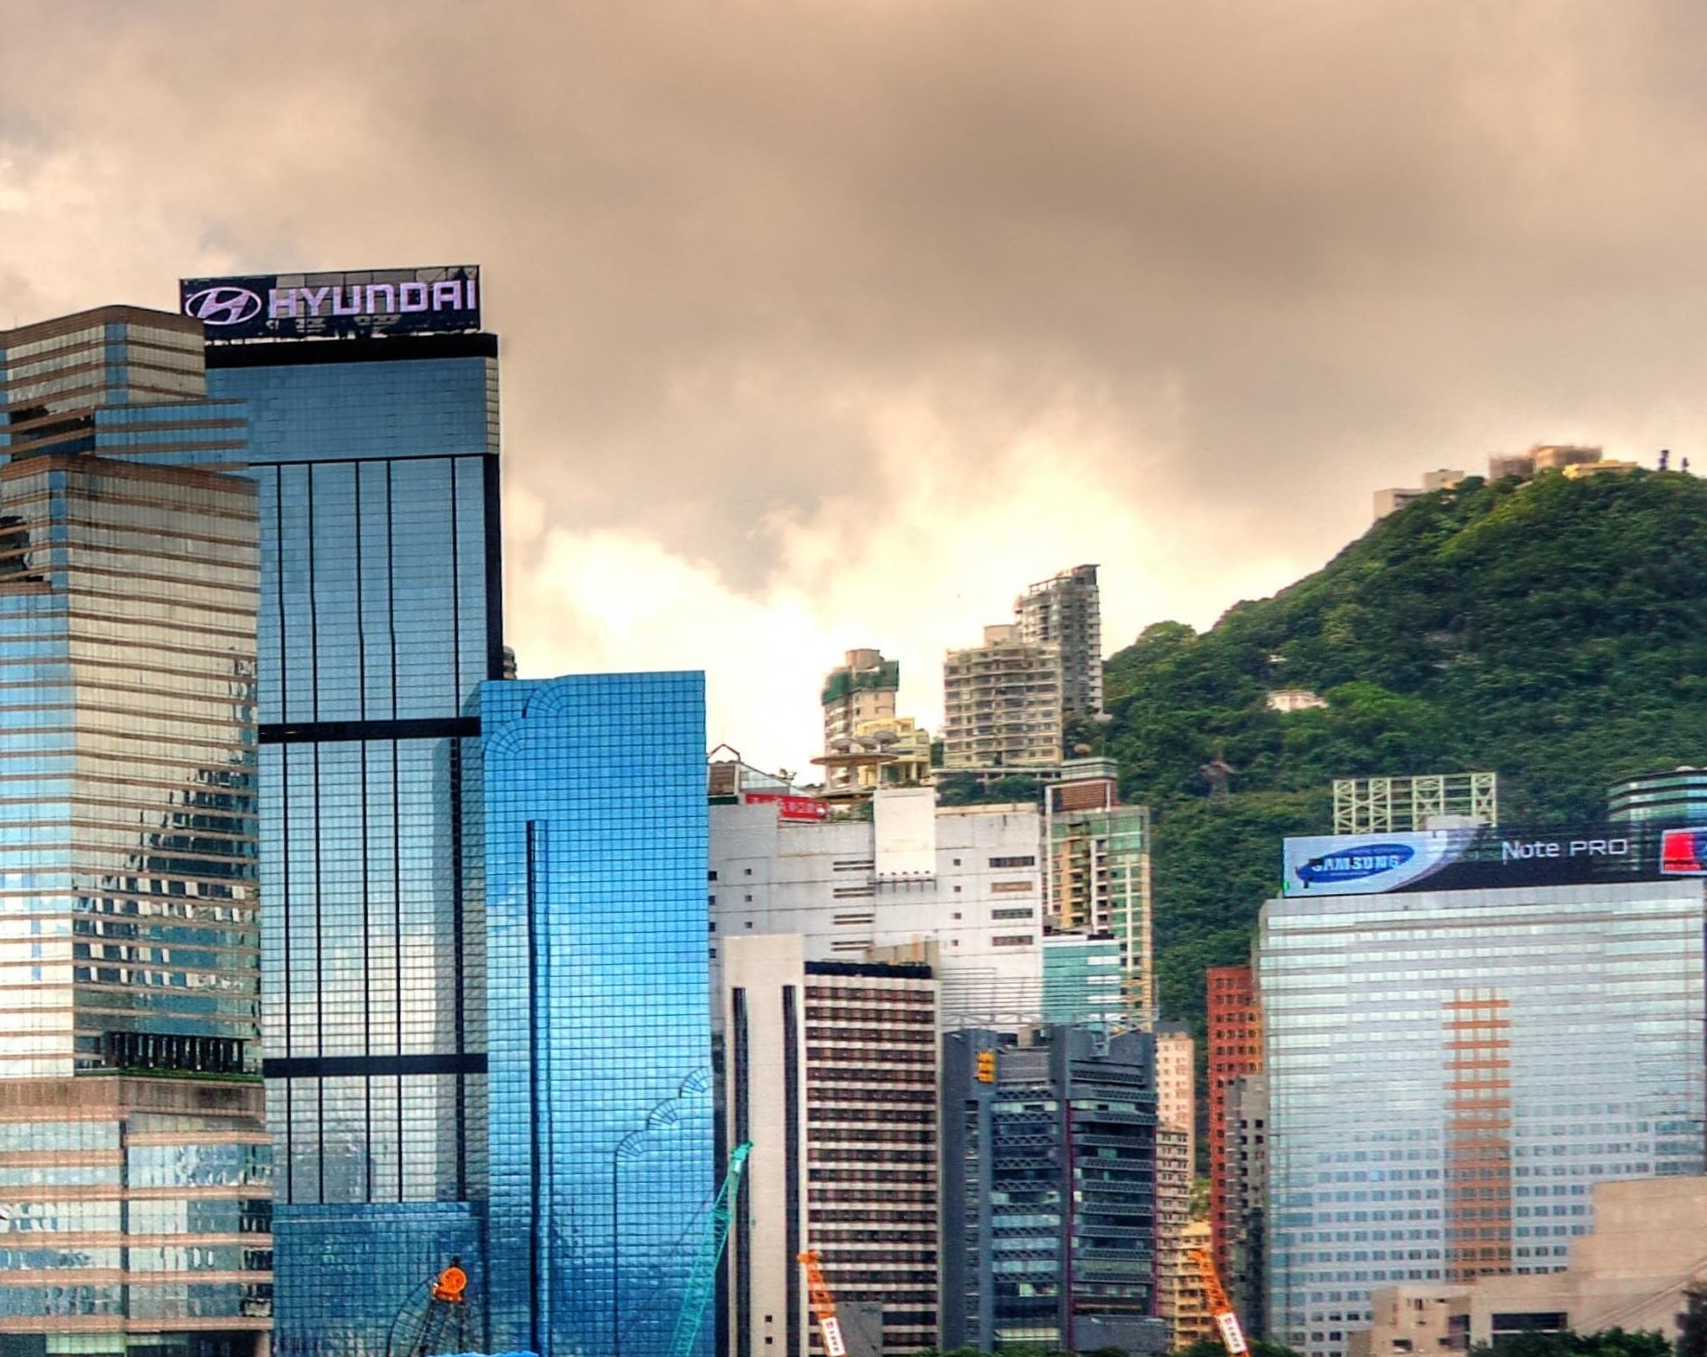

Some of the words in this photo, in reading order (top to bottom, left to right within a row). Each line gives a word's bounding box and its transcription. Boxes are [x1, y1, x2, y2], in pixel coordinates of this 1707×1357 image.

[268, 280, 476, 318] HYUNDAI
[1501, 840, 1560, 861] Note
[1569, 838, 1628, 857] PRO
